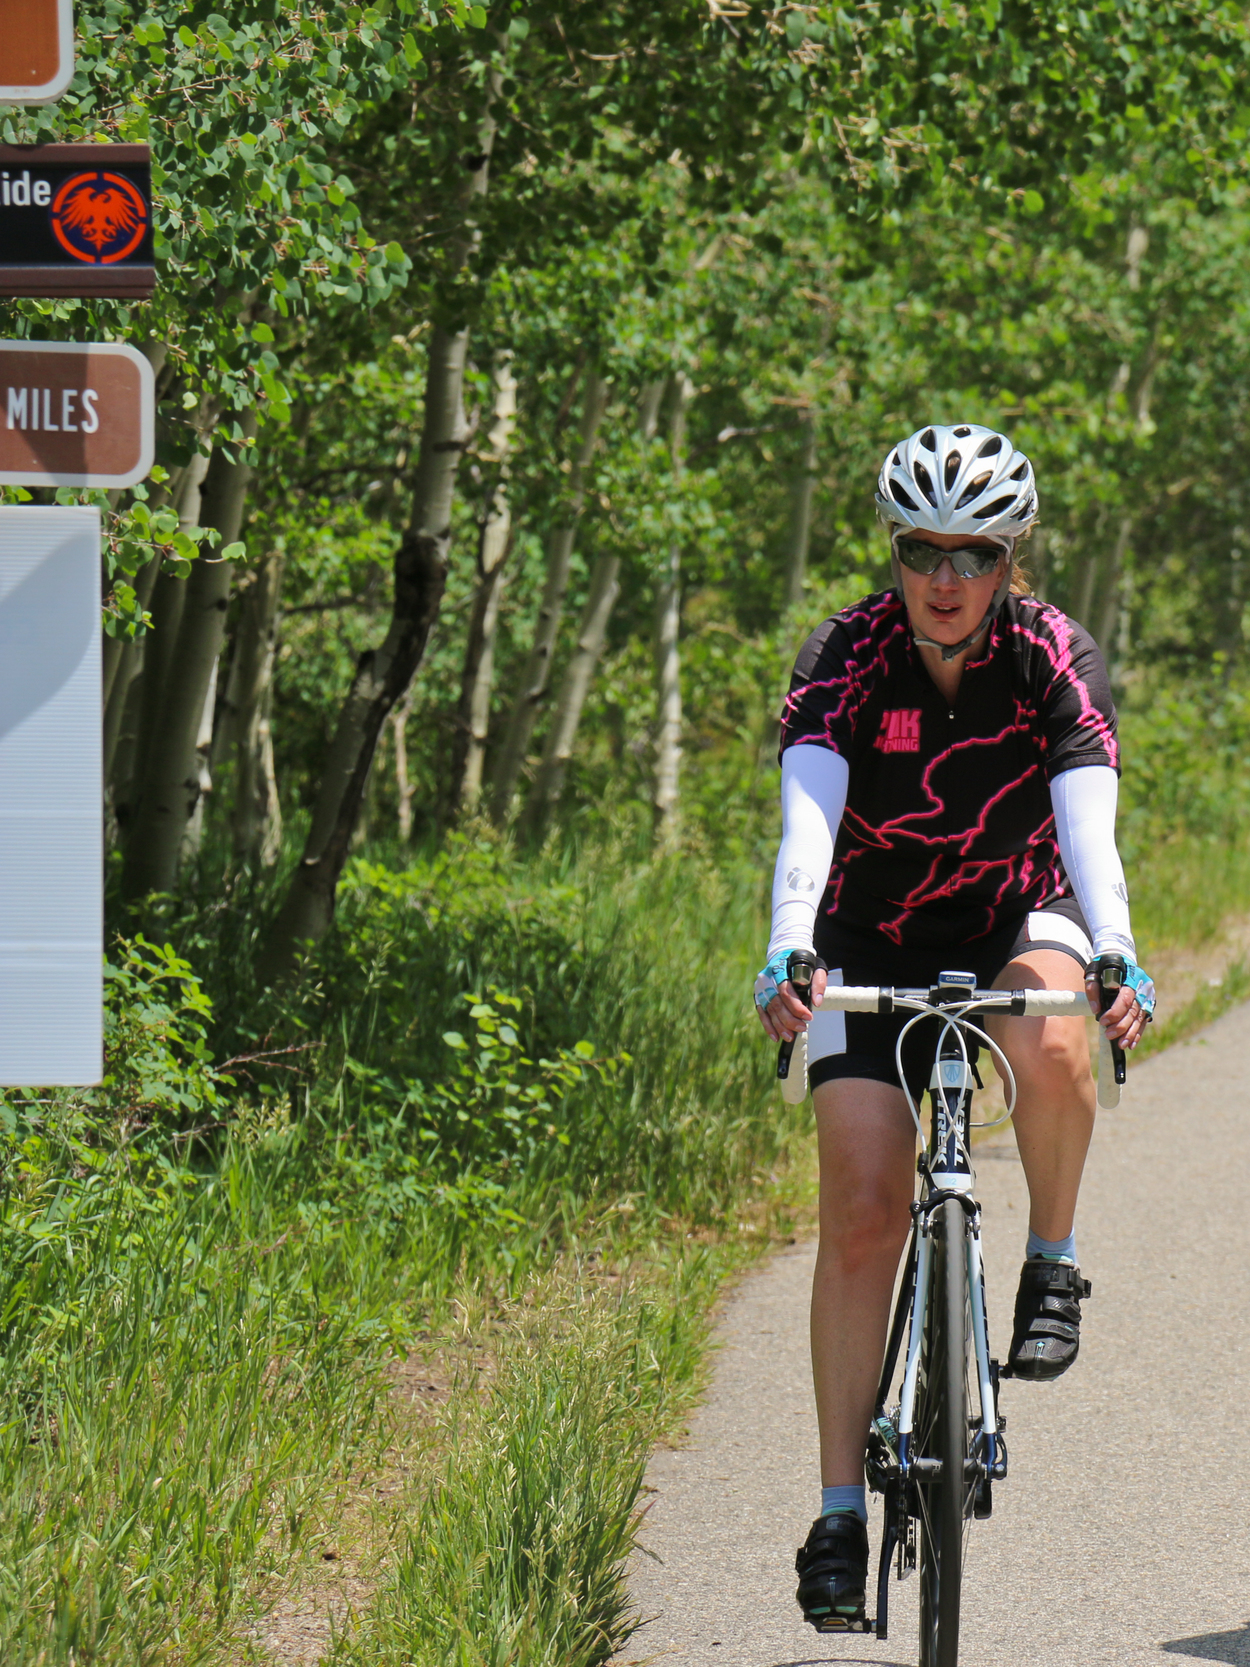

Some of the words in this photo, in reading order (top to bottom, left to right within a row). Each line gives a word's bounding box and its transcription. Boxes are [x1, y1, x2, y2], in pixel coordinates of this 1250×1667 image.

[0, 169, 52, 207] ide
[6, 386, 99, 434] MILES
[937, 1099, 948, 1166] TREK
[954, 1095, 966, 1167] TREK
